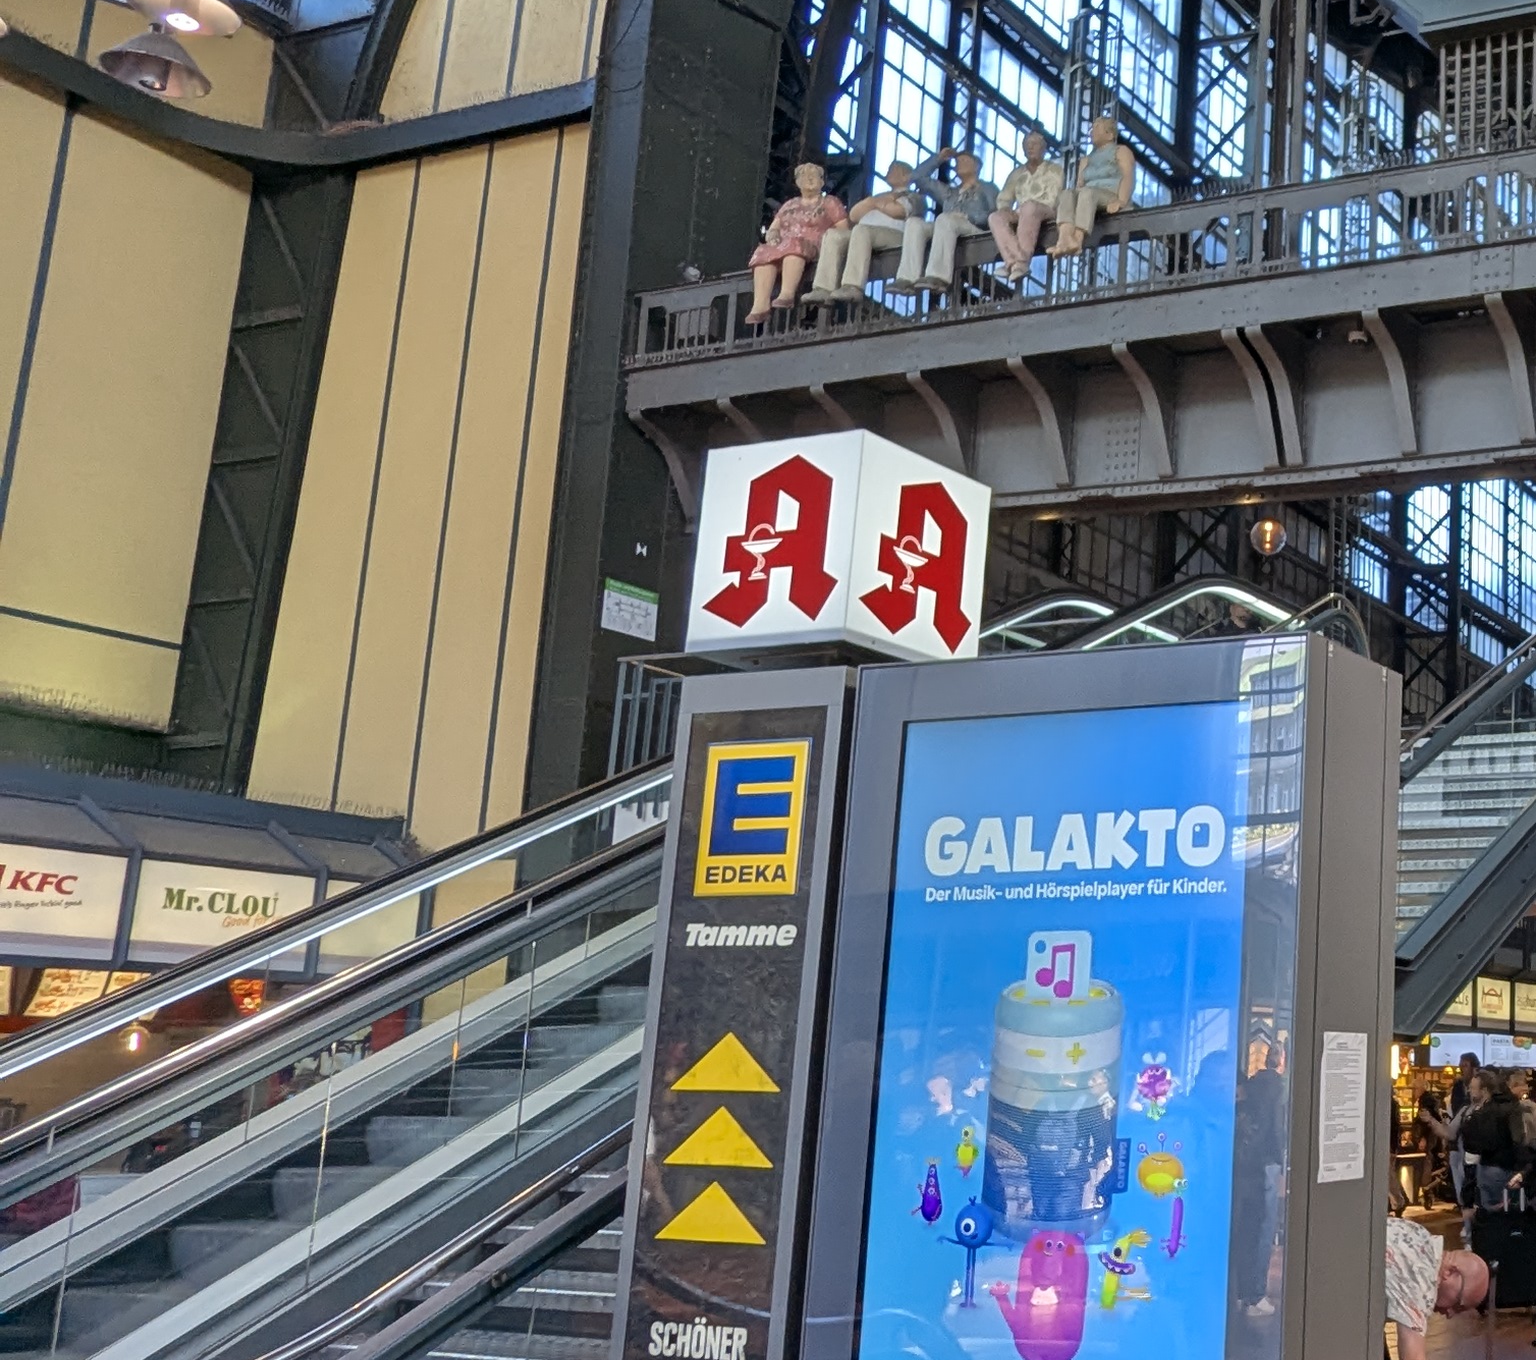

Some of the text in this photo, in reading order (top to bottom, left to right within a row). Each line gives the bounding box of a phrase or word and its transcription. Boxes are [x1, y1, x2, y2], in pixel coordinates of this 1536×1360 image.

[702, 454, 838, 628] A
[858, 481, 972, 655] A
[924, 805, 1227, 877] GALAKTO
[6, 870, 79, 895] KFC
[705, 864, 787, 884] EDEKA
[926, 877, 1227, 902] Der Musik- und Hörspielplayer für Kinder.
[162, 887, 279, 918] Mr. CLOU
[685, 923, 798, 947] Tamme
[1117, 1141, 1128, 1189] GALAKTO
